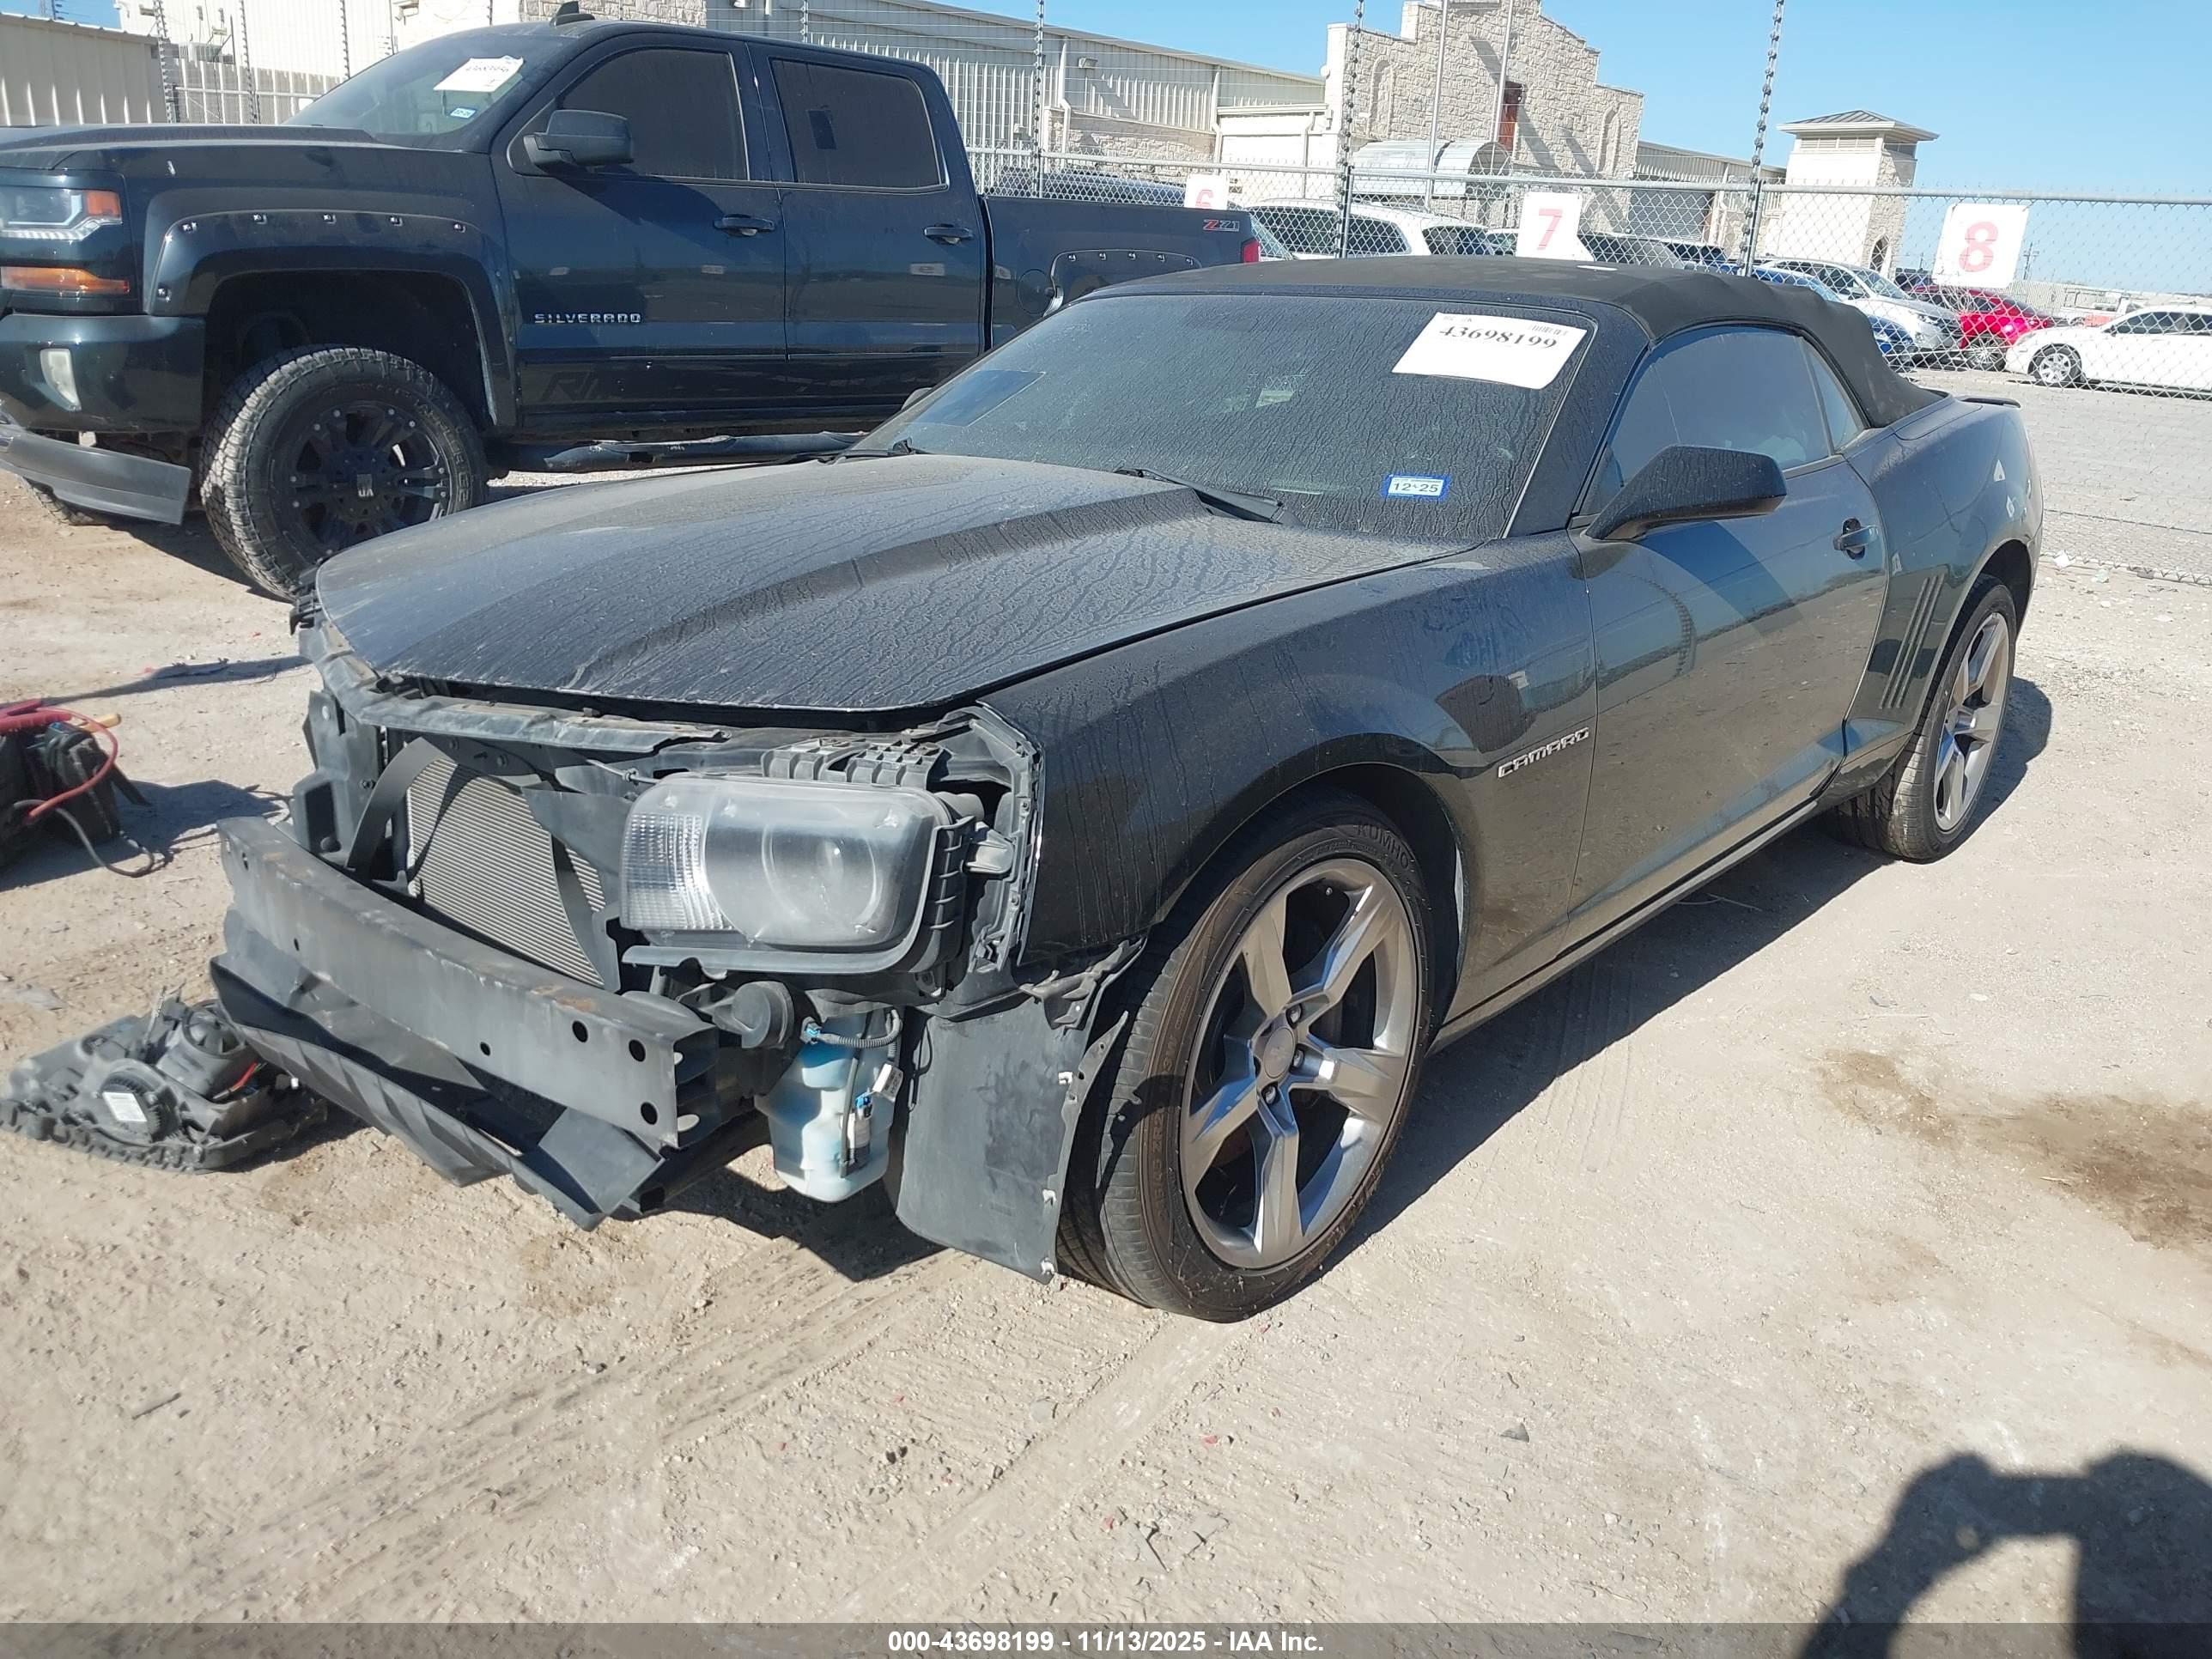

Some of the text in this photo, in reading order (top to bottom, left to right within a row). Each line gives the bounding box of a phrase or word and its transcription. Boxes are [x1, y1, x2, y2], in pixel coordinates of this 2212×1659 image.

[1202, 218, 1240, 232] Z71
[1536, 208, 1564, 251] 7
[1959, 221, 1999, 273] 8
[533, 313, 642, 324] SILVERADO
[1438, 325, 1559, 349] 43698199
[1498, 726, 1589, 779] CAMARO
[1356, 824, 1409, 870] KUMHO
